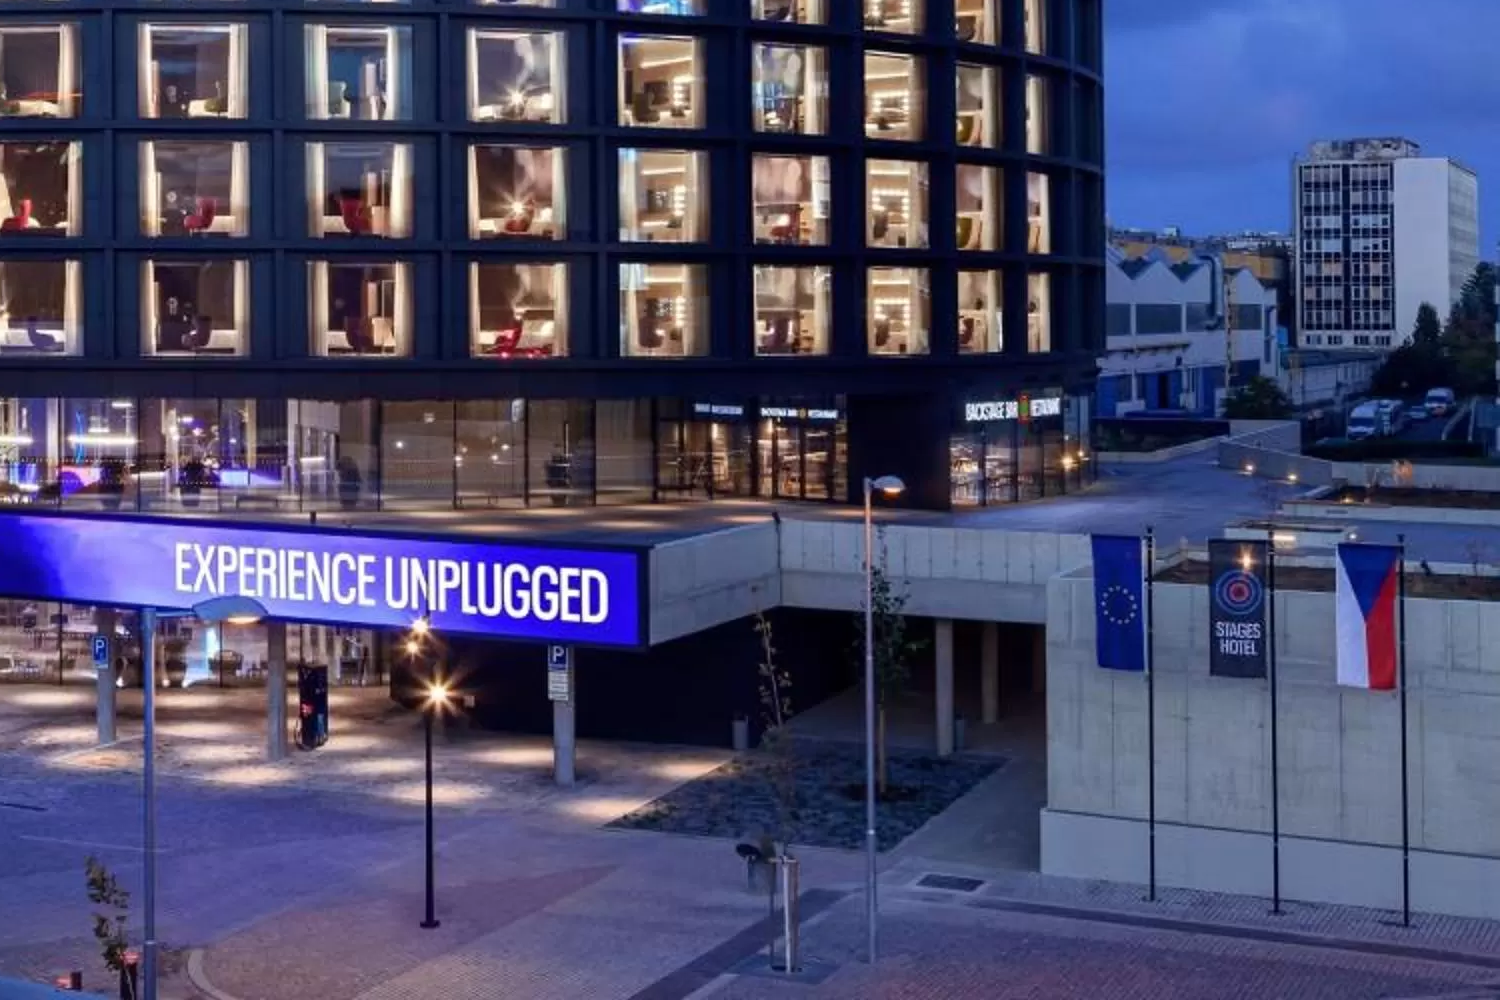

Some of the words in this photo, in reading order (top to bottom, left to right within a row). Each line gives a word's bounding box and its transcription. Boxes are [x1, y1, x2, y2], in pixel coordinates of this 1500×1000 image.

[174, 542, 376, 604] EXPERIENCE
[385, 556, 609, 623] UNPLUGGED
[1215, 621, 1261, 639] STAGES
[95, 639, 105, 655] P
[553, 645, 565, 663] P
[1220, 640, 1258, 656] HOTEL
